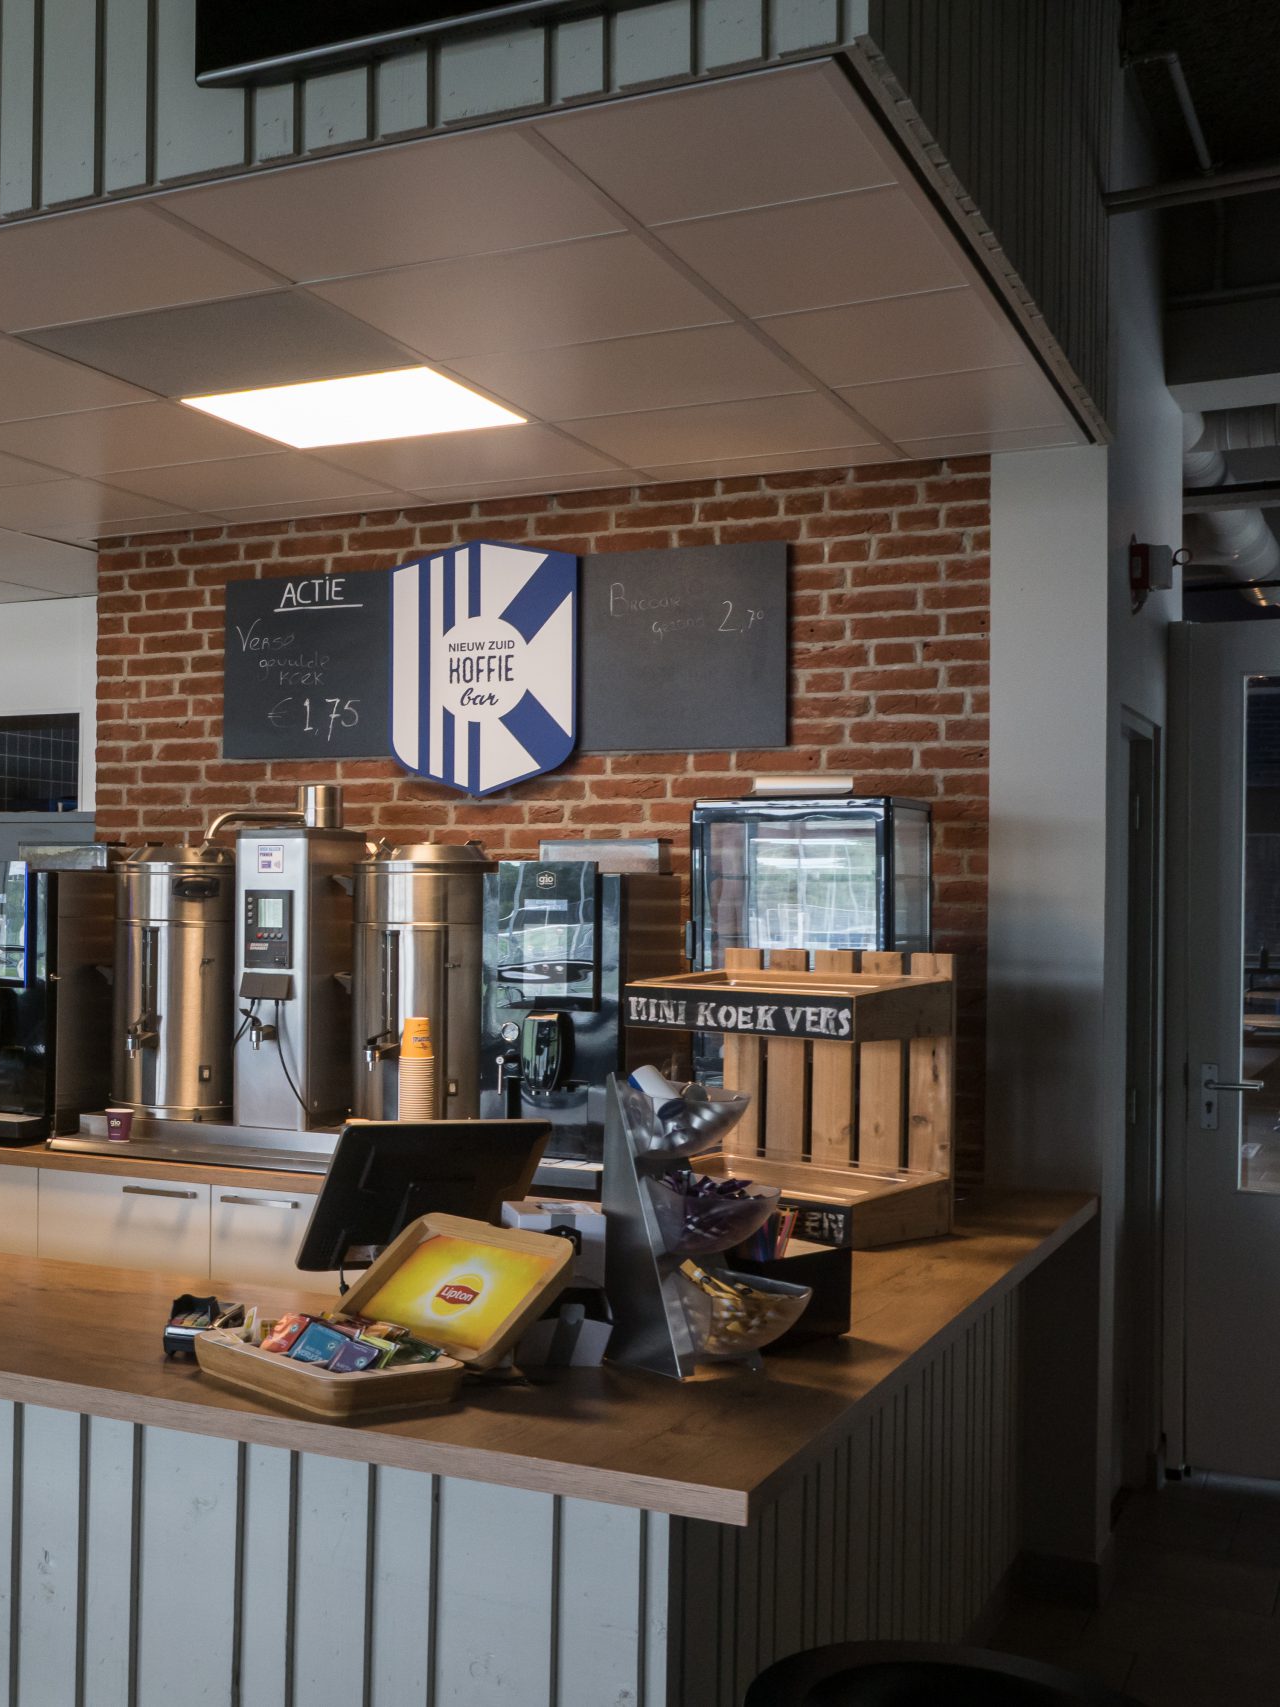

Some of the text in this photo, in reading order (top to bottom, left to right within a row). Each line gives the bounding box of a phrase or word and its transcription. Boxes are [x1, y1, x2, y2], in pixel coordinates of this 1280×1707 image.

[280, 576, 347, 608] ACTIE
[448, 640, 515, 653] NIEUW ZUID
[449, 654, 515, 684] KOFFIE
[460, 687, 499, 706] bar
[538, 874, 554, 886] gio
[696, 1002, 778, 1031] KOEK
[782, 1006, 852, 1037] VERS
[441, 1286, 474, 1302] Lipton
